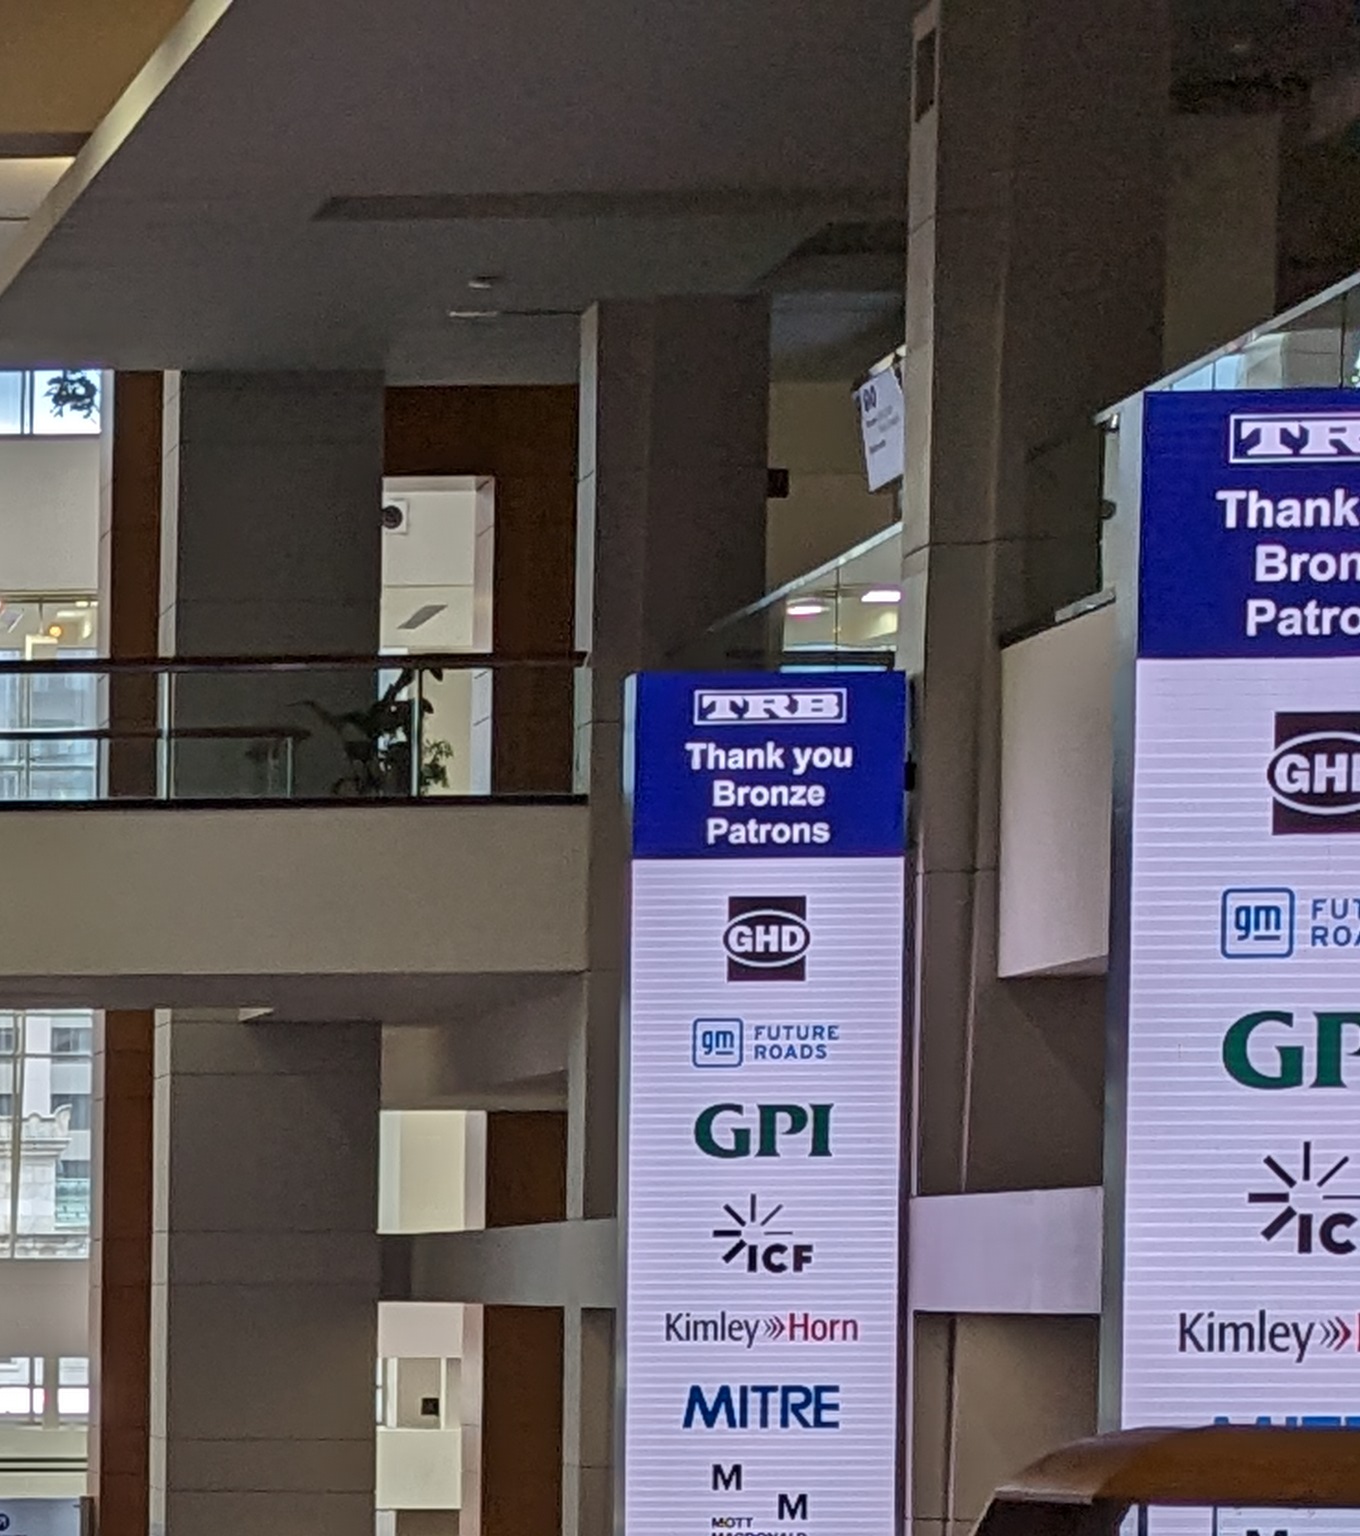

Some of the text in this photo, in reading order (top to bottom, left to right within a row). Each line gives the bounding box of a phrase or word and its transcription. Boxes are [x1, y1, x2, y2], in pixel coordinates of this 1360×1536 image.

[1241, 421, 1360, 455] TR
[1215, 488, 1360, 529] Thank
[1255, 545, 1360, 582] Bron
[1246, 599, 1360, 637] Patro
[703, 693, 840, 719] TRB
[685, 742, 853, 775] Thank you
[713, 780, 826, 807] Bronze
[706, 818, 831, 844] Patrons
[728, 925, 805, 952] GHD
[754, 1025, 839, 1040] FUTURE
[754, 1044, 827, 1059] ROADS
[1222, 1010, 1360, 1089] GP
[694, 1102, 834, 1158] GPI
[1298, 1212, 1358, 1254] IC
[747, 1244, 813, 1273] ICF
[665, 1311, 858, 1348] Kimley Horn
[1179, 1309, 1315, 1364] Kimley
[682, 1385, 839, 1428] MITRE
[712, 1464, 742, 1490] M
[712, 1517, 753, 1528] MOTT
[778, 1494, 808, 1520] M
